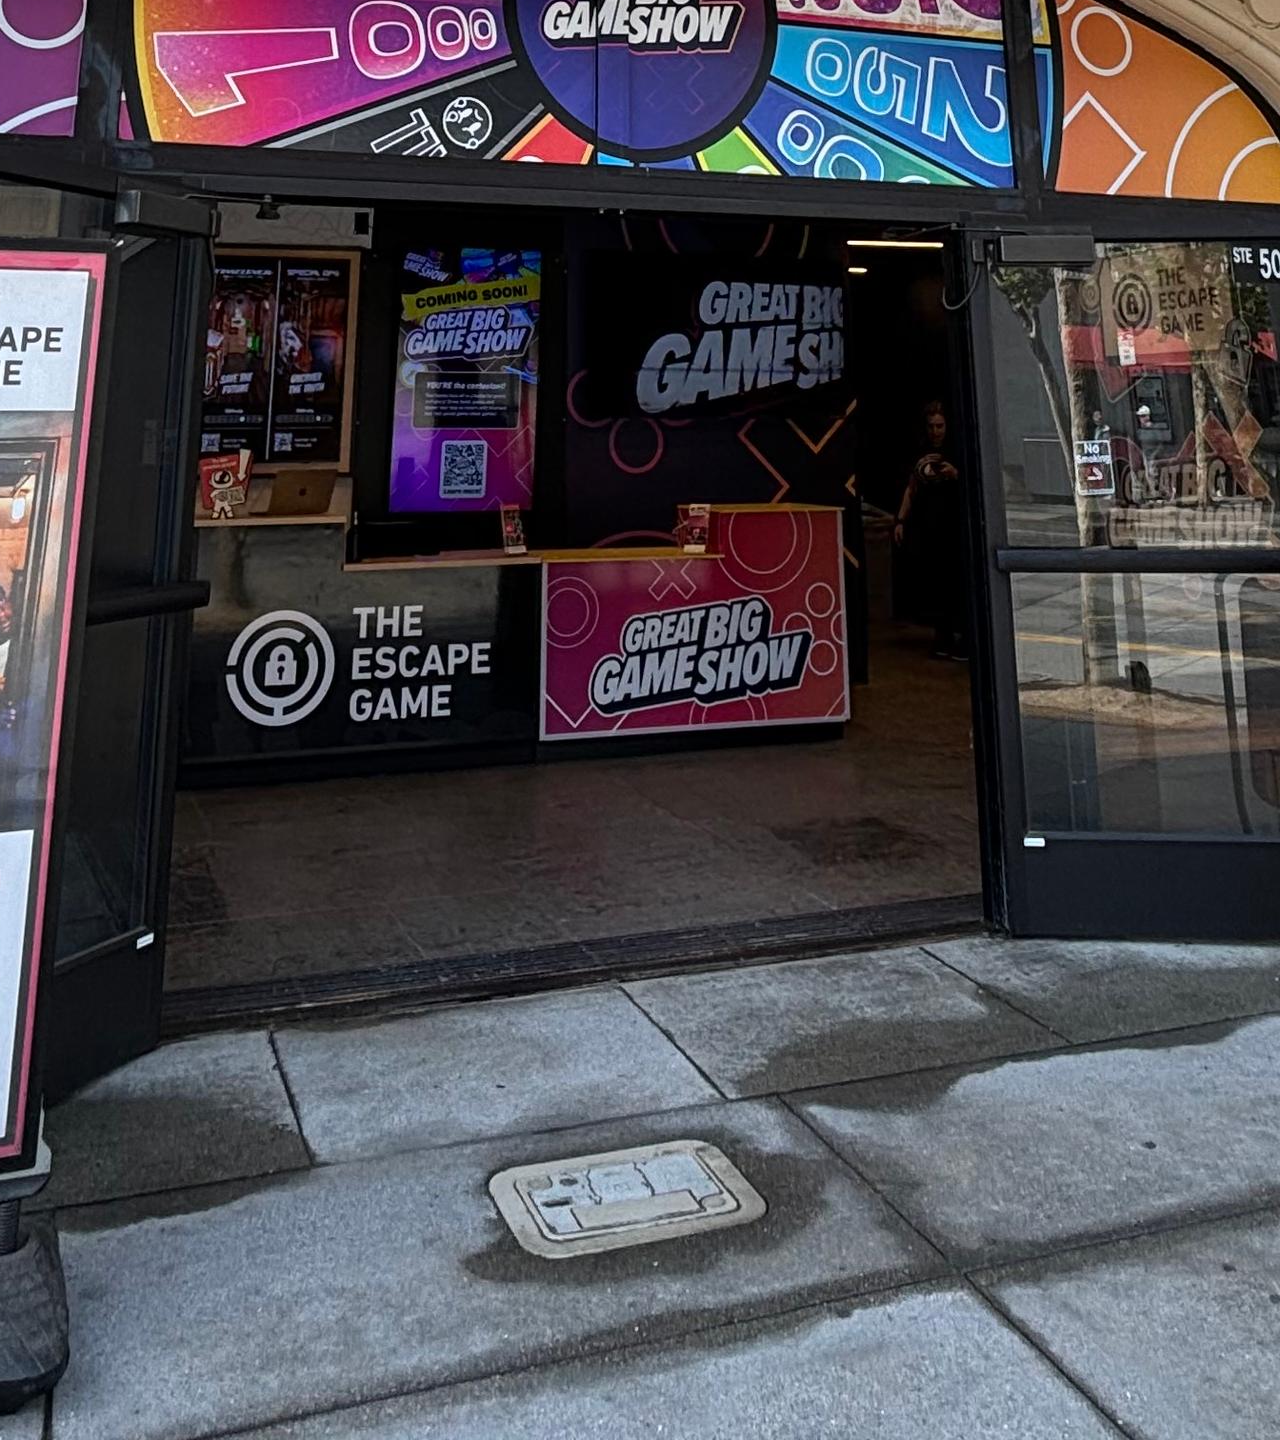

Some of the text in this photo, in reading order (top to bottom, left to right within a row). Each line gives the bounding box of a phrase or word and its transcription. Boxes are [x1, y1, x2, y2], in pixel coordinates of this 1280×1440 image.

[628, 5, 733, 44] SHOW
[1233, 247, 1253, 264] STE
[1156, 267, 1185, 287] THE
[416, 285, 528, 309] COMING SOON!
[699, 280, 800, 325] GREAT
[426, 309, 505, 332] GREAT BIG
[407, 328, 526, 355] GAME SHOW
[636, 325, 797, 415] GAME
[353, 605, 423, 639] THE
[625, 602, 764, 650] GREAT BIG
[351, 642, 491, 680] ESCAPE
[595, 638, 805, 705] GAME SHOW
[349, 685, 451, 721] GAME
